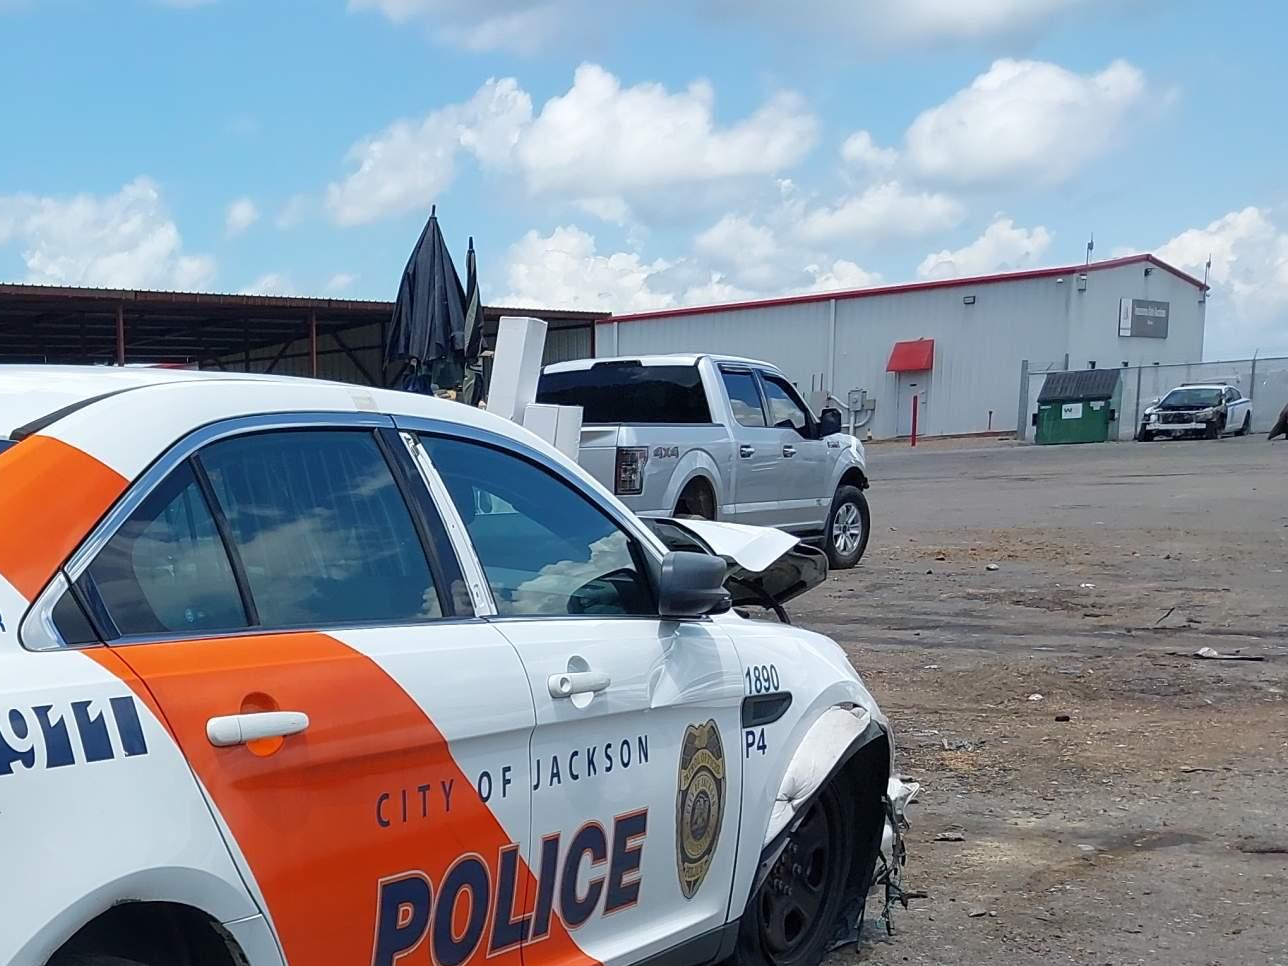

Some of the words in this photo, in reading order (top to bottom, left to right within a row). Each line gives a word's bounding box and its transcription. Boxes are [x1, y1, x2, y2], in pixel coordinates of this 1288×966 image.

[745, 663, 780, 695] 1890
[745, 728, 767, 758] P4
[376, 778, 455, 828] CITY
[477, 766, 512, 803] OF
[533, 735, 649, 791] JACKSON
